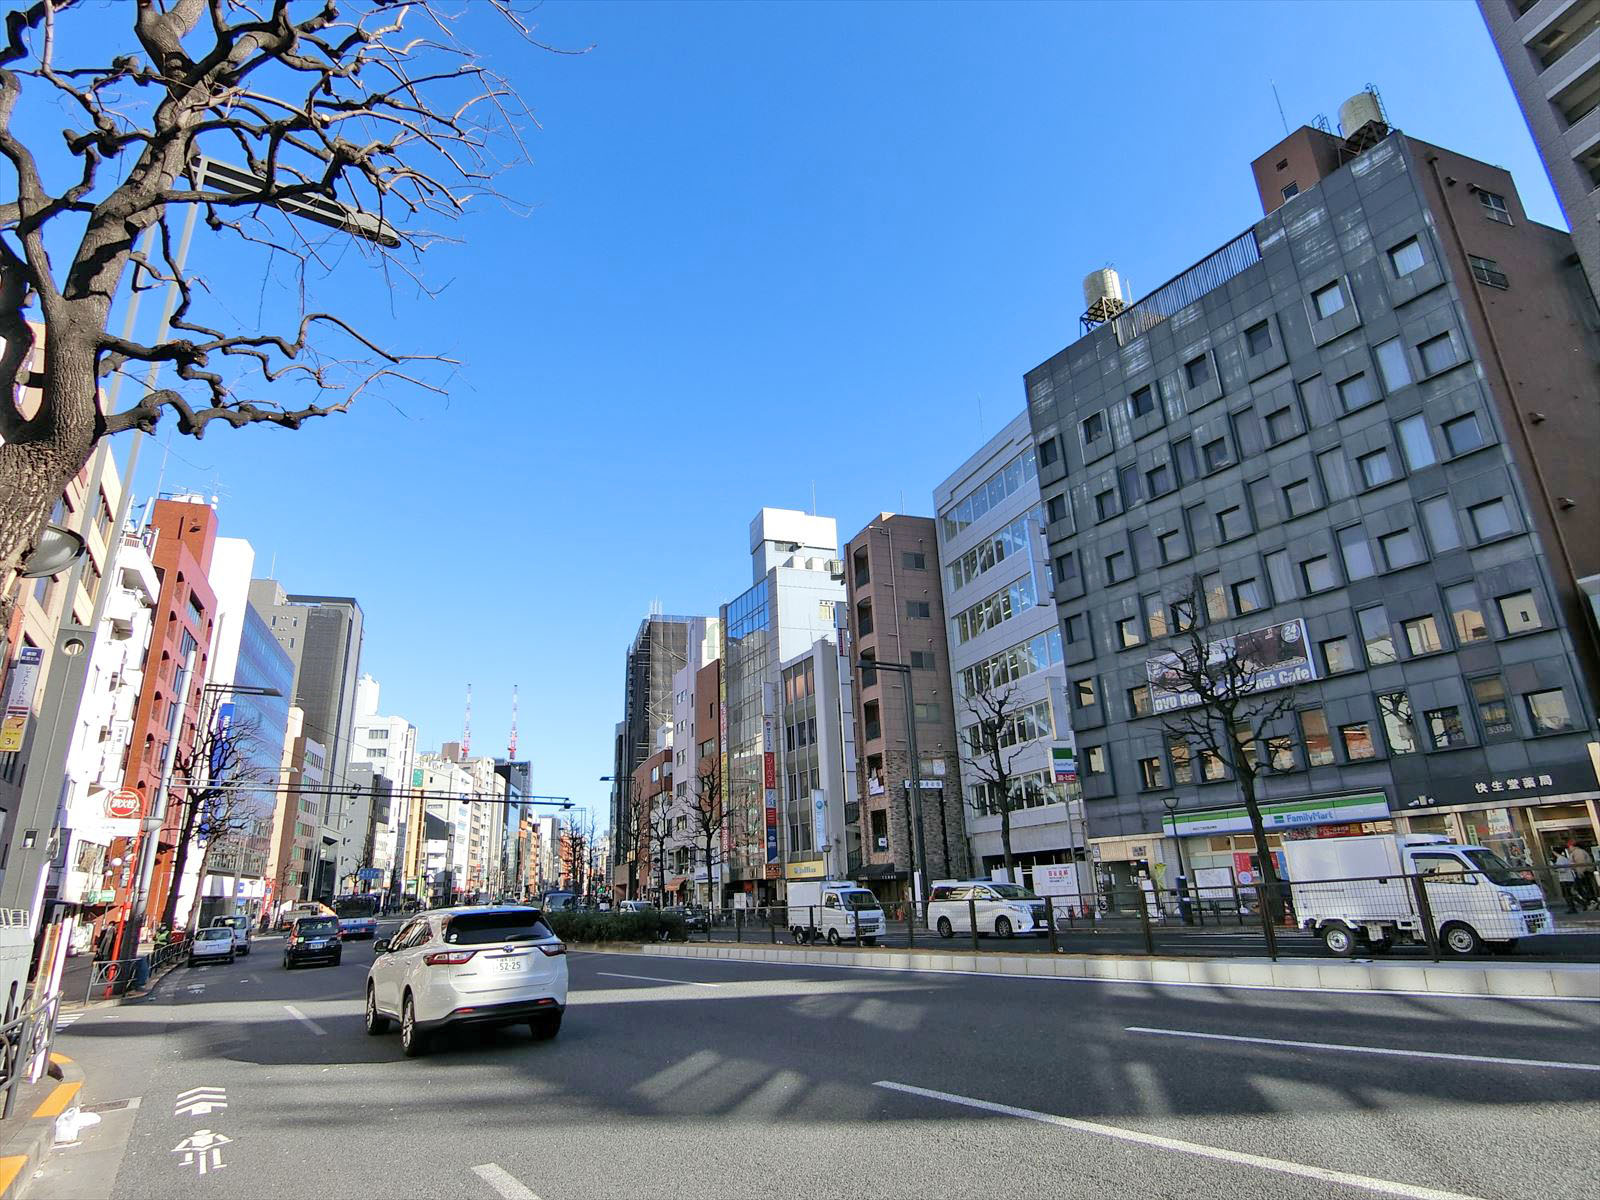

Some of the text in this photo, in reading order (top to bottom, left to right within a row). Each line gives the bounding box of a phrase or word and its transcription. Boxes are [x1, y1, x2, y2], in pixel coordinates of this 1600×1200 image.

[1284, 624, 1297, 635] 24
[1155, 696, 1178, 712] DVD
[1279, 667, 1310, 685] Cafe
[1474, 774, 1553, 794] 快生堂薬局
[1286, 811, 1333, 823] FamilyMart
[499, 962, 521, 970] 52-25
